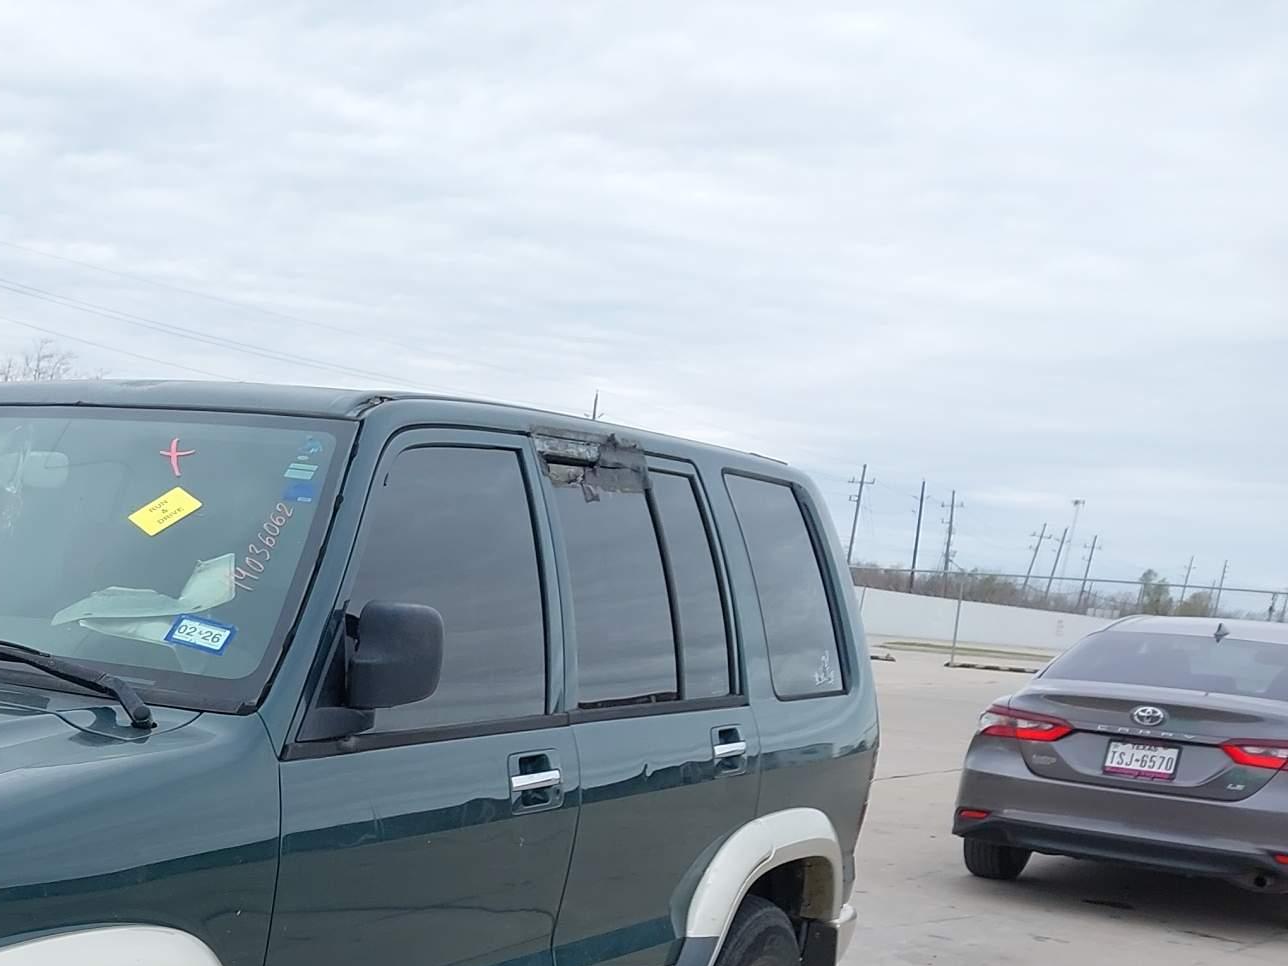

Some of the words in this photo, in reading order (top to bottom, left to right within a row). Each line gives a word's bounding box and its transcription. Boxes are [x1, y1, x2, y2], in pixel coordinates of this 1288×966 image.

[149, 499, 168, 513] RUN
[156, 507, 185, 524] DRIVE
[177, 624, 198, 637] 02
[201, 630, 223, 644] 26
[1110, 751, 1175, 771] TSJ-6570
